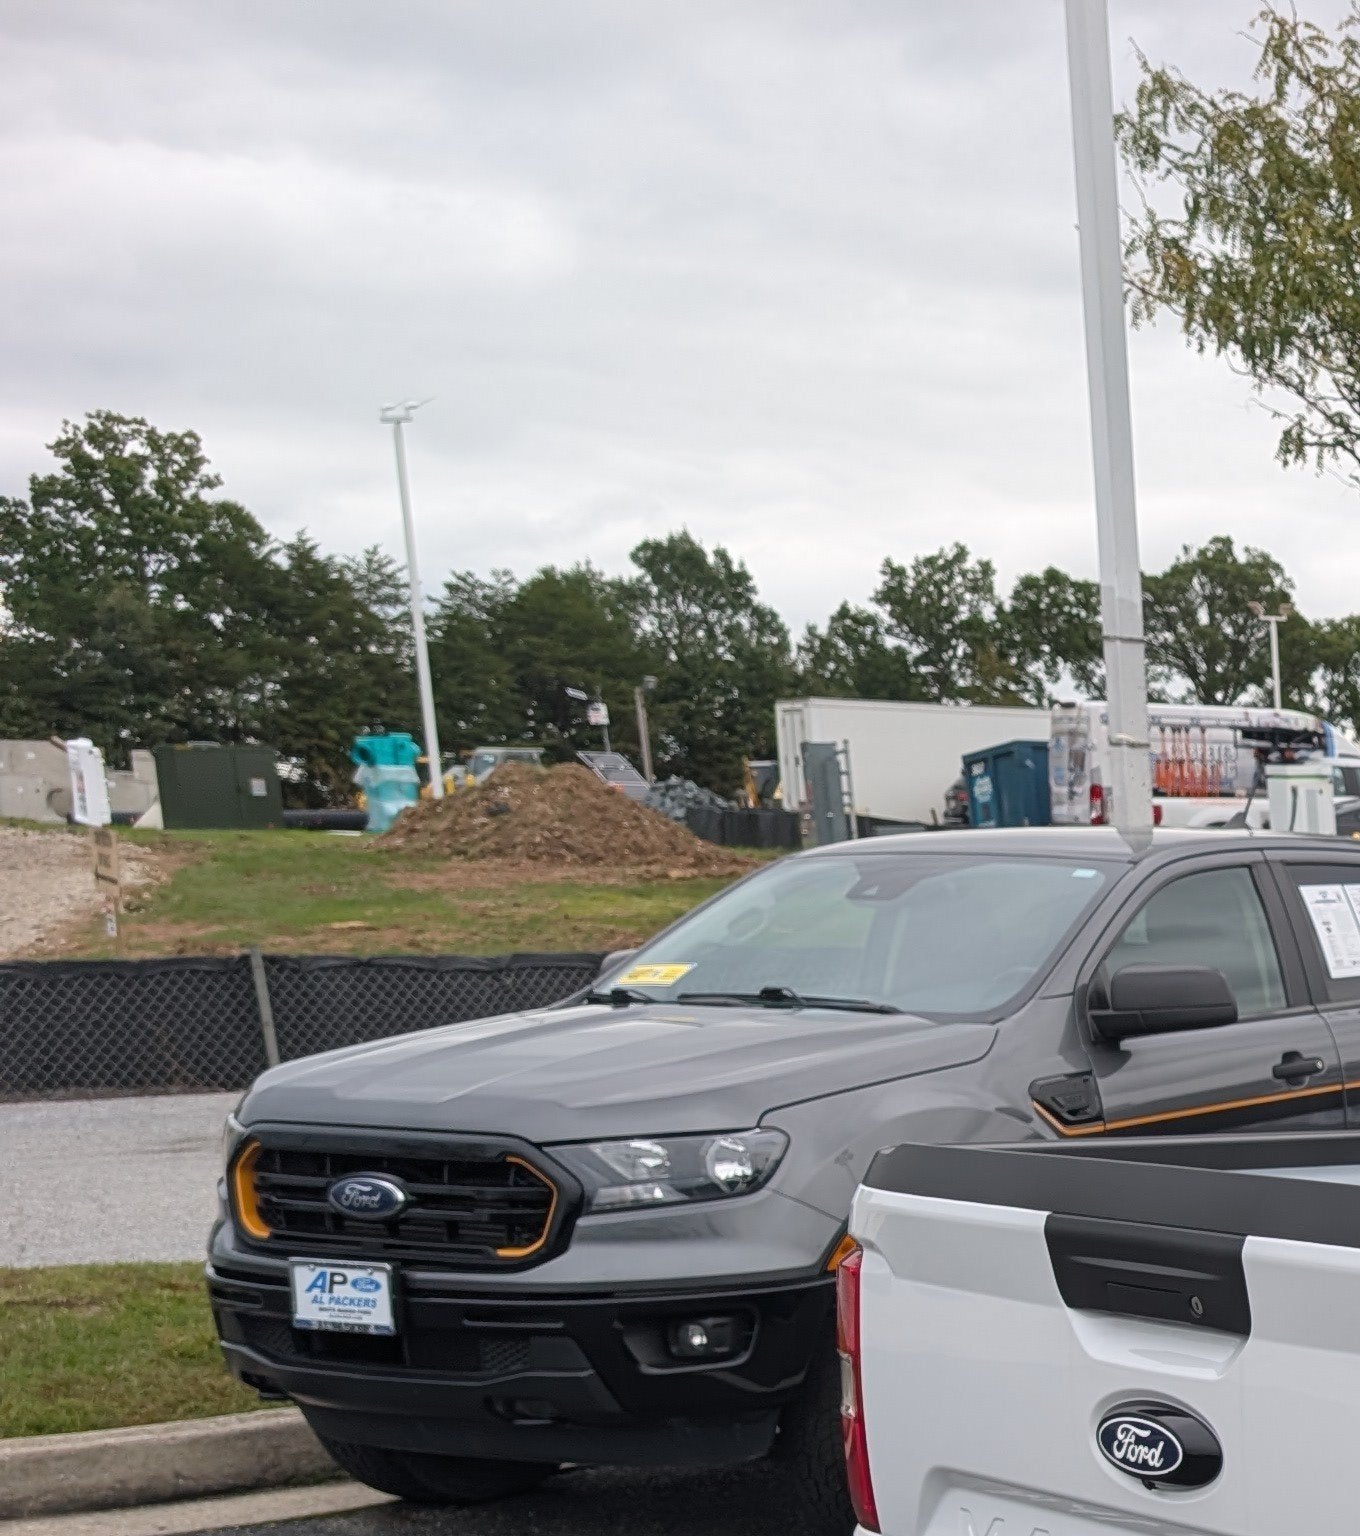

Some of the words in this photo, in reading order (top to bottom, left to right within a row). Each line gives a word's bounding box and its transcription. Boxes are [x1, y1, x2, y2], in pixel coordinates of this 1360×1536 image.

[341, 1183, 382, 1208] Ford
[305, 1271, 348, 1294] AP
[328, 1296, 377, 1309] PACKERS
[1113, 1424, 1164, 1468] Ford
